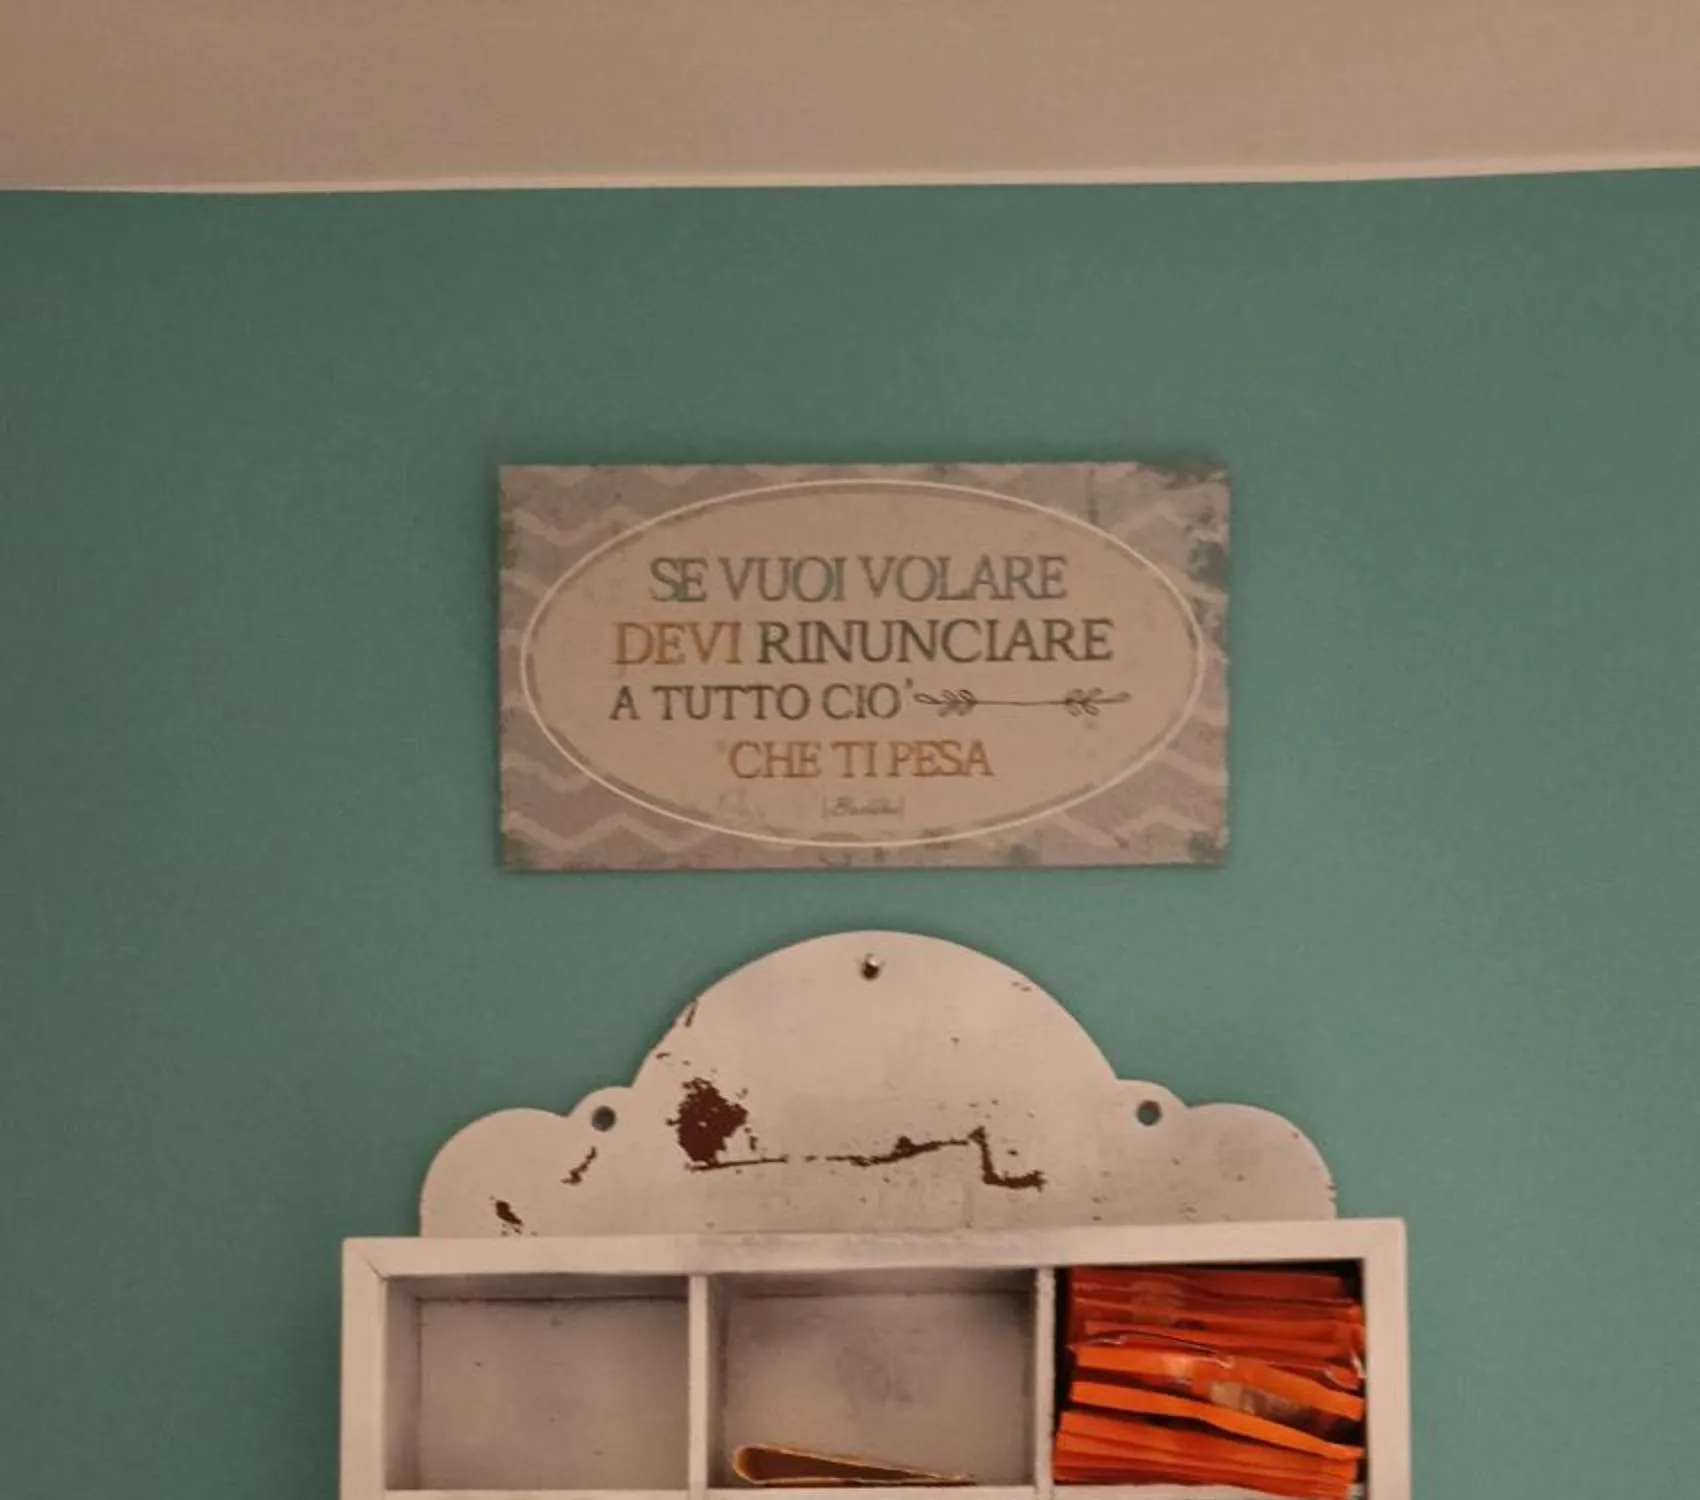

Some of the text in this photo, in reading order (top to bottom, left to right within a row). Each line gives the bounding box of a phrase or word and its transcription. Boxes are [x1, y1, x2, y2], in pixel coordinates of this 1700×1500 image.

[649, 554, 1069, 602] SE VUOI VOLARE
[613, 618, 1115, 666] DEVI RINUNCIARE
[608, 677, 914, 721] A TUTTO CIO'
[728, 739, 996, 779] CHE TI PESA
